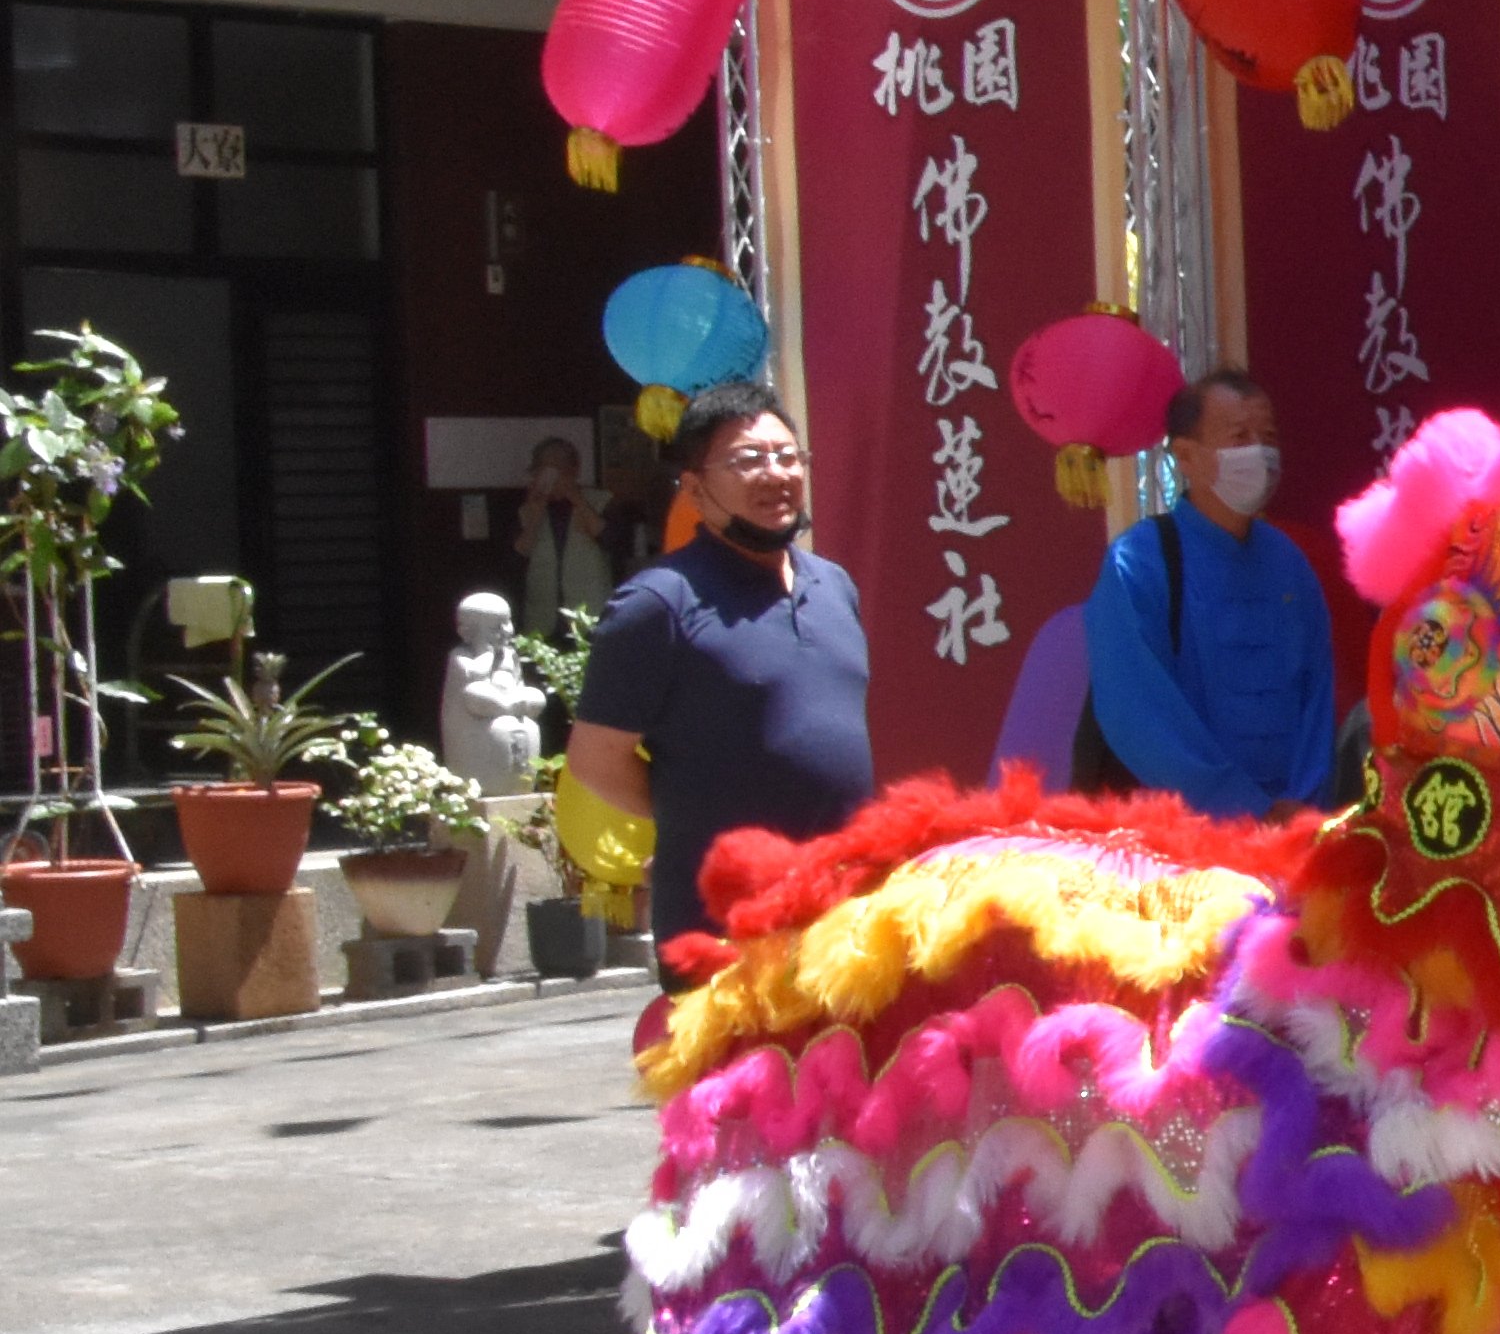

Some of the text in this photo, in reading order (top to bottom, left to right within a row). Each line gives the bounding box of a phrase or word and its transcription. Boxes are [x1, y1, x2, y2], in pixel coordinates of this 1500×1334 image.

[872, 18, 1019, 116] 桃園
[911, 135, 1011, 665] 佛教蓮社
